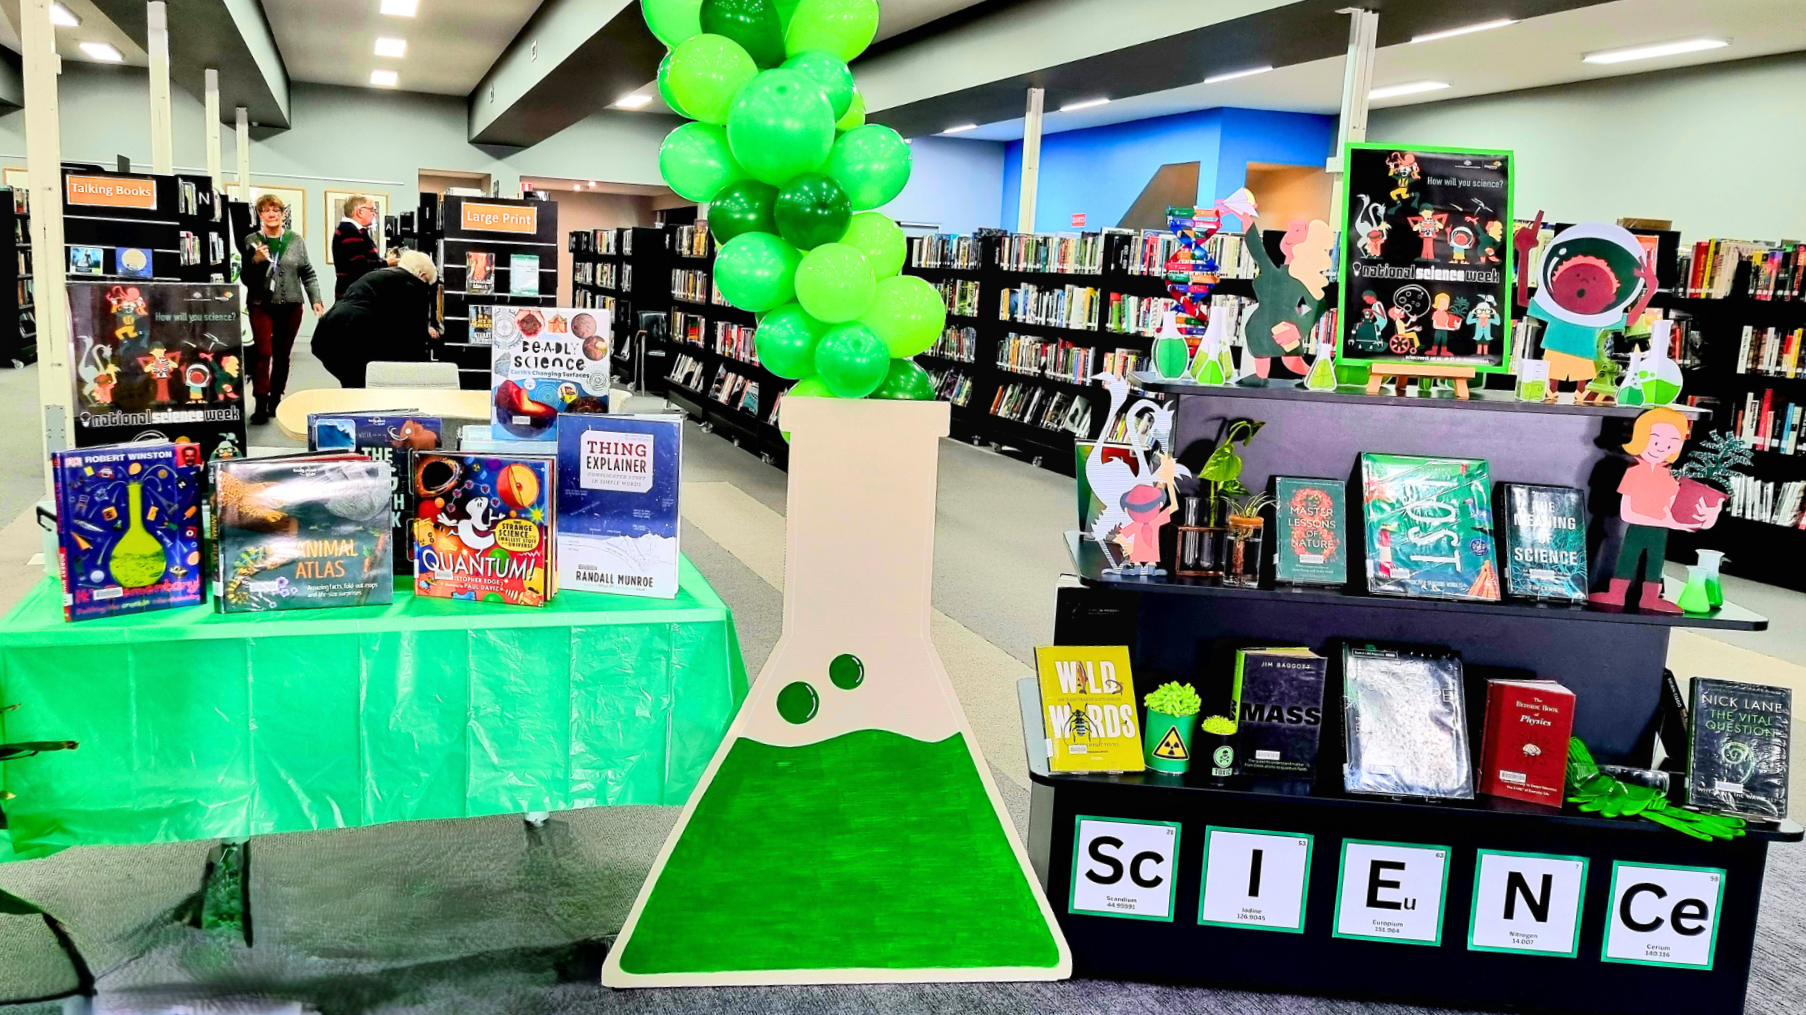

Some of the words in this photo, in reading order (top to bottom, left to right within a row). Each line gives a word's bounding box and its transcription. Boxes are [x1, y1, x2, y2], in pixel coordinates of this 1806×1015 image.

[71, 182, 113, 196] Talking
[116, 185, 151, 197] Books
[1427, 176, 1442, 186] How
[1444, 177, 1457, 187] will
[1458, 179, 1471, 189] you
[1472, 178, 1504, 189] science?
[198, 192, 210, 205] N
[466, 210, 499, 226] Large
[502, 212, 532, 225] Print
[155, 313, 172, 321] How
[173, 312, 188, 322] will
[189, 314, 202, 324] you
[203, 312, 237, 322] science?
[532, 370, 561, 378] Changing
[562, 371, 590, 379] Surfaces
[361, 447, 394, 463] THE
[587, 440, 647, 457] THING
[84, 454, 126, 464] ROBERT
[127, 450, 173, 461] WINSTON
[586, 455, 647, 473] EXPLAINER
[587, 472, 627, 480] COMPLICATED
[1289, 506, 1334, 517] MASTER
[502, 523, 533, 532] STRANGE
[1288, 517, 1336, 529] LESSONS
[1513, 513, 1577, 530] MEANING
[498, 529, 529, 538] SCIENCE
[1306, 530, 1318, 538] OF
[296, 539, 358, 558] ANIMAL
[1290, 538, 1334, 549] NATURE
[1514, 547, 1579, 566] SCIENCE
[295, 560, 346, 579] ATLAS
[422, 549, 536, 582] QUANTUM!
[484, 578, 500, 586] EDGE
[575, 570, 614, 584] RANDALL
[617, 573, 654, 588] MUNROE
[1054, 661, 1117, 694] WLD
[1228, 699, 1238, 720] MA
[1542, 705, 1559, 713] BOOK
[1701, 694, 1738, 709] NICK
[1744, 698, 1783, 713] LANE
[1048, 704, 1136, 739] WRDS
[1242, 702, 1322, 726] MASS
[1520, 714, 1552, 727] Physics
[1711, 709, 1735, 720] THE
[1739, 712, 1772, 725] VITAL
[1705, 720, 1777, 738] QUESTION
[1085, 835, 1165, 889] Sc
[1248, 848, 1263, 897] I
[1366, 859, 1417, 911] Eu
[1106, 895, 1137, 904] Scandium
[1503, 871, 1553, 923] N
[1619, 882, 1710, 937] Ce
[1372, 919, 1404, 928] Europium
[1509, 931, 1538, 939] Nitrogen
[1646, 943, 1671, 951] Cerium
